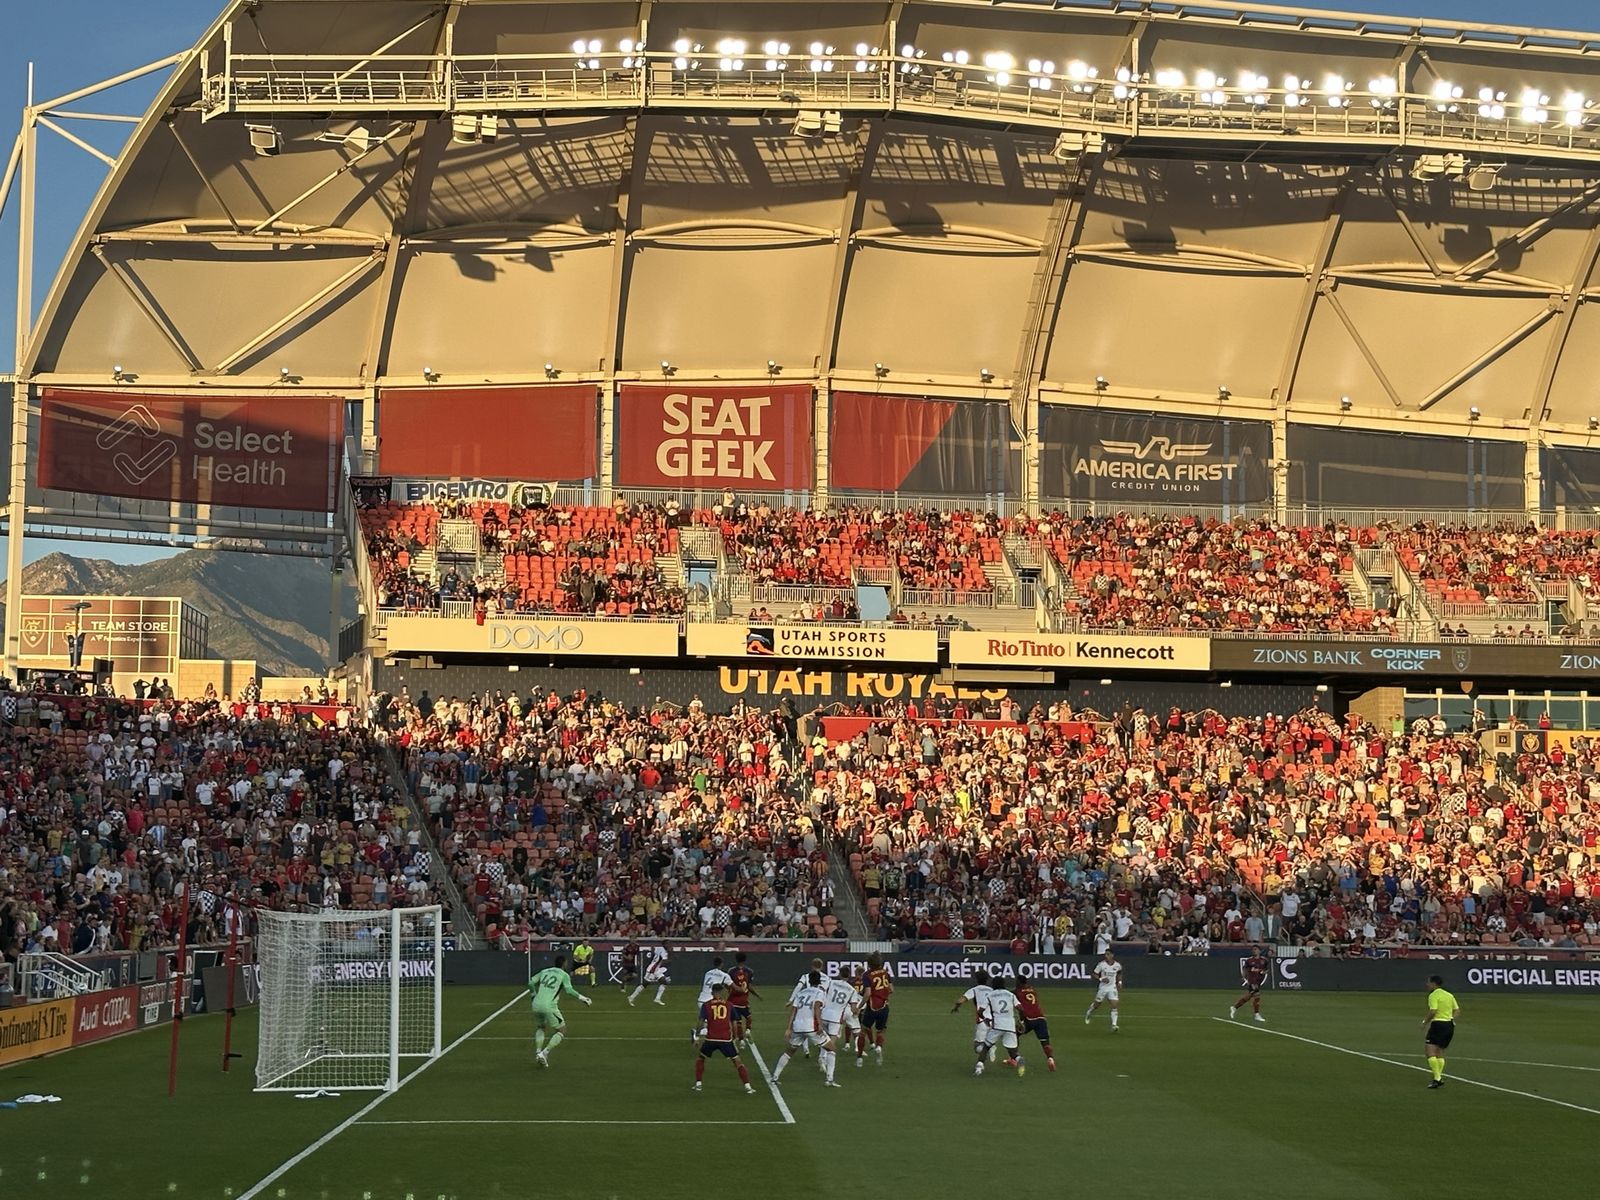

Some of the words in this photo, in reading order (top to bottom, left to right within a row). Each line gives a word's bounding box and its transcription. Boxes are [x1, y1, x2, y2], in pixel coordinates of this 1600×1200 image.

[663, 394, 771, 436] SEAT
[193, 422, 293, 454] Select
[656, 438, 776, 481] GEEK
[193, 455, 286, 486] Health
[1074, 458, 1171, 480] AMERICA
[1175, 463, 1238, 481] FIRST
[407, 480, 508, 500] EPICENTRO
[1111, 481, 1155, 490] CREDIT
[1162, 484, 1200, 492] UNION
[91, 621, 125, 631] TEAM
[128, 621, 169, 631] STORE
[490, 624, 584, 650] DOMO
[781, 630, 822, 641] UTAH
[828, 632, 886, 643] SPORTS
[781, 645, 885, 658] COMMISSION
[1076, 642, 1174, 660] Kennecott
[1253, 649, 1308, 664] ZIONS
[1312, 651, 1363, 665] BANK
[1370, 648, 1441, 660] CORNER
[1386, 660, 1424, 671] KICK
[720, 666, 832, 696] UTAH
[334, 961, 384, 980] ENERGY
[388, 960, 435, 978] RINK
[1018, 962, 1092, 979] OFICIAL
[1467, 968, 1551, 985] OFFICIAL
[541, 974, 557, 989] 42
[873, 975, 889, 990] 26
[832, 989, 847, 1004] 18
[1025, 994, 1035, 1004] 9
[711, 1004, 727, 1020] 10
[998, 1000, 1008, 1013] 2
[79, 1004, 99, 1031] Audi
[0, 1011, 41, 1049] ntinental
[49, 1007, 67, 1038] Tire
